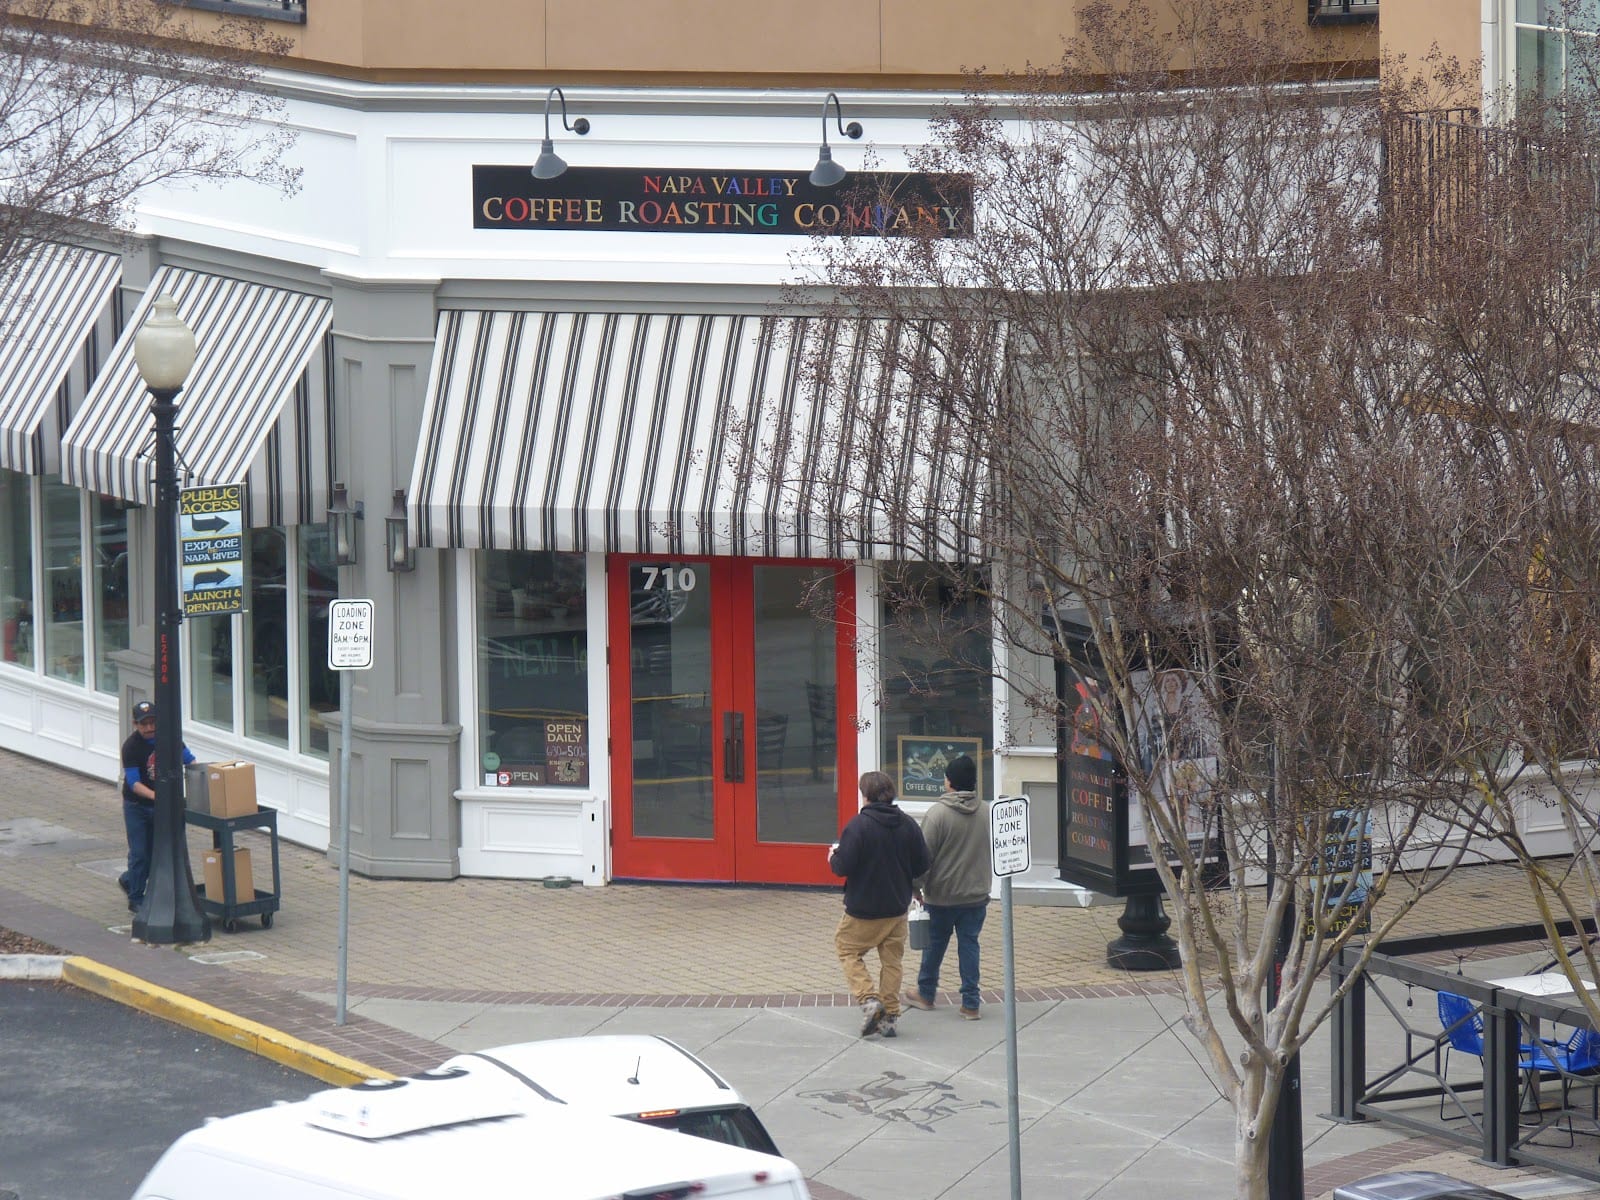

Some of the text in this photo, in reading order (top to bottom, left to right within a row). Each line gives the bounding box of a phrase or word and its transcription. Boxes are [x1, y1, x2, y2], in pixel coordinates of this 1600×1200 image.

[643, 176, 799, 197] NAPA VALLEY
[482, 196, 603, 223] COFFEE
[619, 200, 779, 228] ROASTING
[182, 488, 239, 504] PUBLIC
[181, 499, 240, 515] ACCESS
[184, 538, 239, 552] EXPLORE
[185, 550, 240, 563] NAPA RIVER
[642, 567, 696, 592] 710
[184, 588, 241, 604] LAUNCH &
[187, 600, 239, 613] RENTALS
[337, 607, 367, 618] LOADING
[339, 620, 365, 630] ZONE
[333, 633, 348, 643] 8AM
[353, 633, 369, 643] 6PM
[546, 723, 582, 733] OPEN
[546, 733, 582, 743] DAILY
[1072, 787, 1113, 812] COFFEE
[996, 804, 1023, 820] LOADING
[998, 820, 1022, 833] ZONE
[994, 837, 1008, 849] 8AM
[1012, 835, 1026, 847] 6PM
